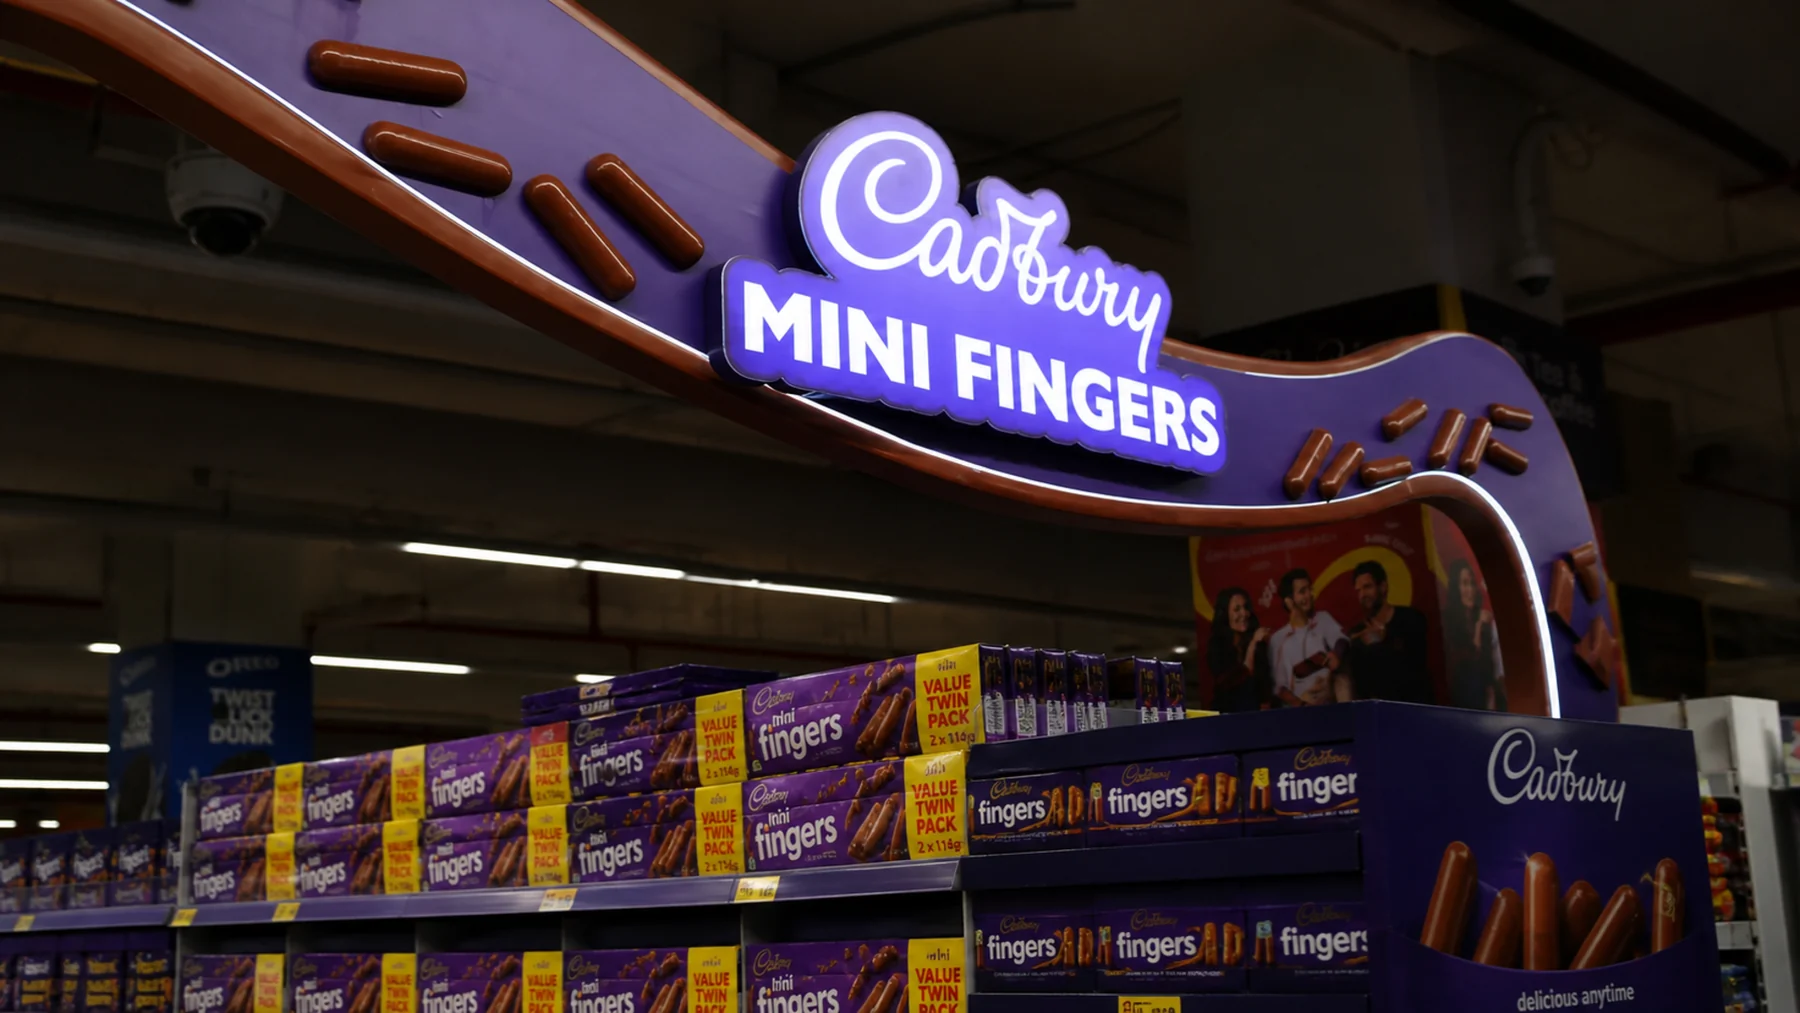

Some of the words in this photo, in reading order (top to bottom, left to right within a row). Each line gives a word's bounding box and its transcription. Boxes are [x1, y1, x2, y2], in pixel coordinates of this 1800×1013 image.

[820, 131, 1162, 372] Cadbury
[743, 281, 930, 390] MINI
[954, 333, 1221, 457] FINGERS
[923, 674, 972, 695] VALUE
[926, 692, 969, 710] TWIN
[702, 715, 737, 732] VALUE
[927, 710, 970, 729] PACK
[208, 722, 275, 746] DUNK
[705, 732, 734, 748] TWIN
[758, 713, 843, 761] fingers
[705, 747, 736, 763] PACK
[579, 749, 643, 787] fingers
[1487, 728, 1626, 821] Cadbury
[431, 771, 485, 808] fingers
[911, 779, 958, 799] VALUE
[915, 798, 955, 816] TWIN
[1107, 784, 1188, 818] fingers
[701, 809, 737, 824] VALUE
[978, 798, 1046, 828] fingers
[704, 825, 734, 840] TWIN
[916, 815, 958, 835] PACK
[704, 840, 735, 856] PACK
[755, 815, 837, 861] fingers
[428, 850, 483, 885] fingers
[578, 838, 644, 877] fingers
[986, 934, 1058, 965] fingers
[1116, 931, 1197, 963] fingers
[693, 972, 730, 986] VALUE
[915, 967, 961, 984] VALUE
[695, 989, 727, 1002] TWIN
[918, 985, 959, 1002] TWIN
[1517, 988, 1579, 1012] delicious
[1581, 982, 1635, 1010] anytime
